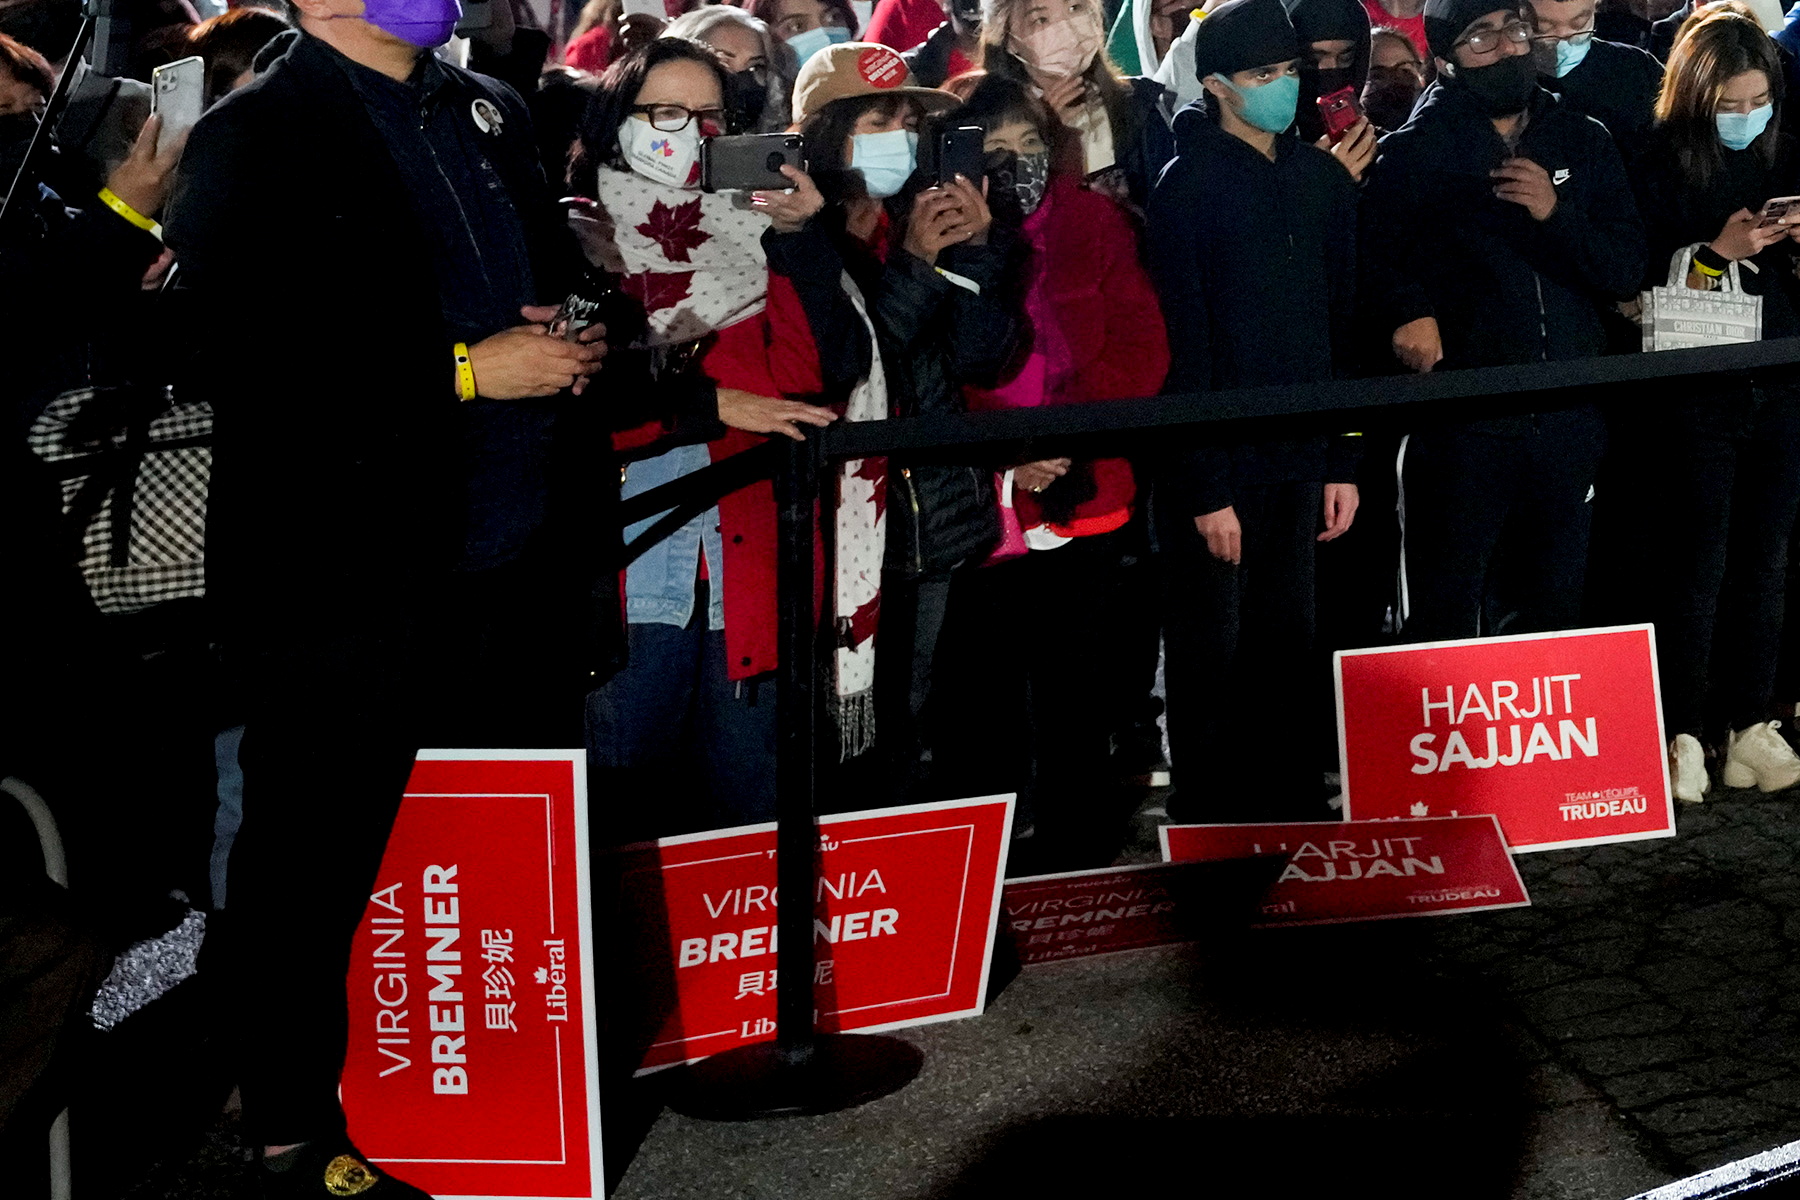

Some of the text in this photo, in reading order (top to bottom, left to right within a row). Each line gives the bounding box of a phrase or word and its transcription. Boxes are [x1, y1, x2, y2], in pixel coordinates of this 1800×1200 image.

[1673, 320, 1723, 336] CHRISTIAN
[1725, 325, 1746, 338] DIOR
[1422, 673, 1582, 727] HARJIT
[1409, 717, 1599, 775] SAJJAN
[1558, 797, 1648, 821] TRUDEAU
[1564, 790, 1592, 802] TEAM
[1277, 856, 1446, 884] AJJAN
[702, 868, 887, 919] VIRNIA
[1406, 888, 1501, 904] TRUDEAU
[1010, 901, 1177, 932] REMNER
[678, 907, 899, 969] BRENER
[370, 882, 412, 1078] VIRGINIA
[423, 863, 469, 1095] BREMNER
[481, 928, 518, 1033] 貝珍妮
[740, 1009, 818, 1039] Libl
